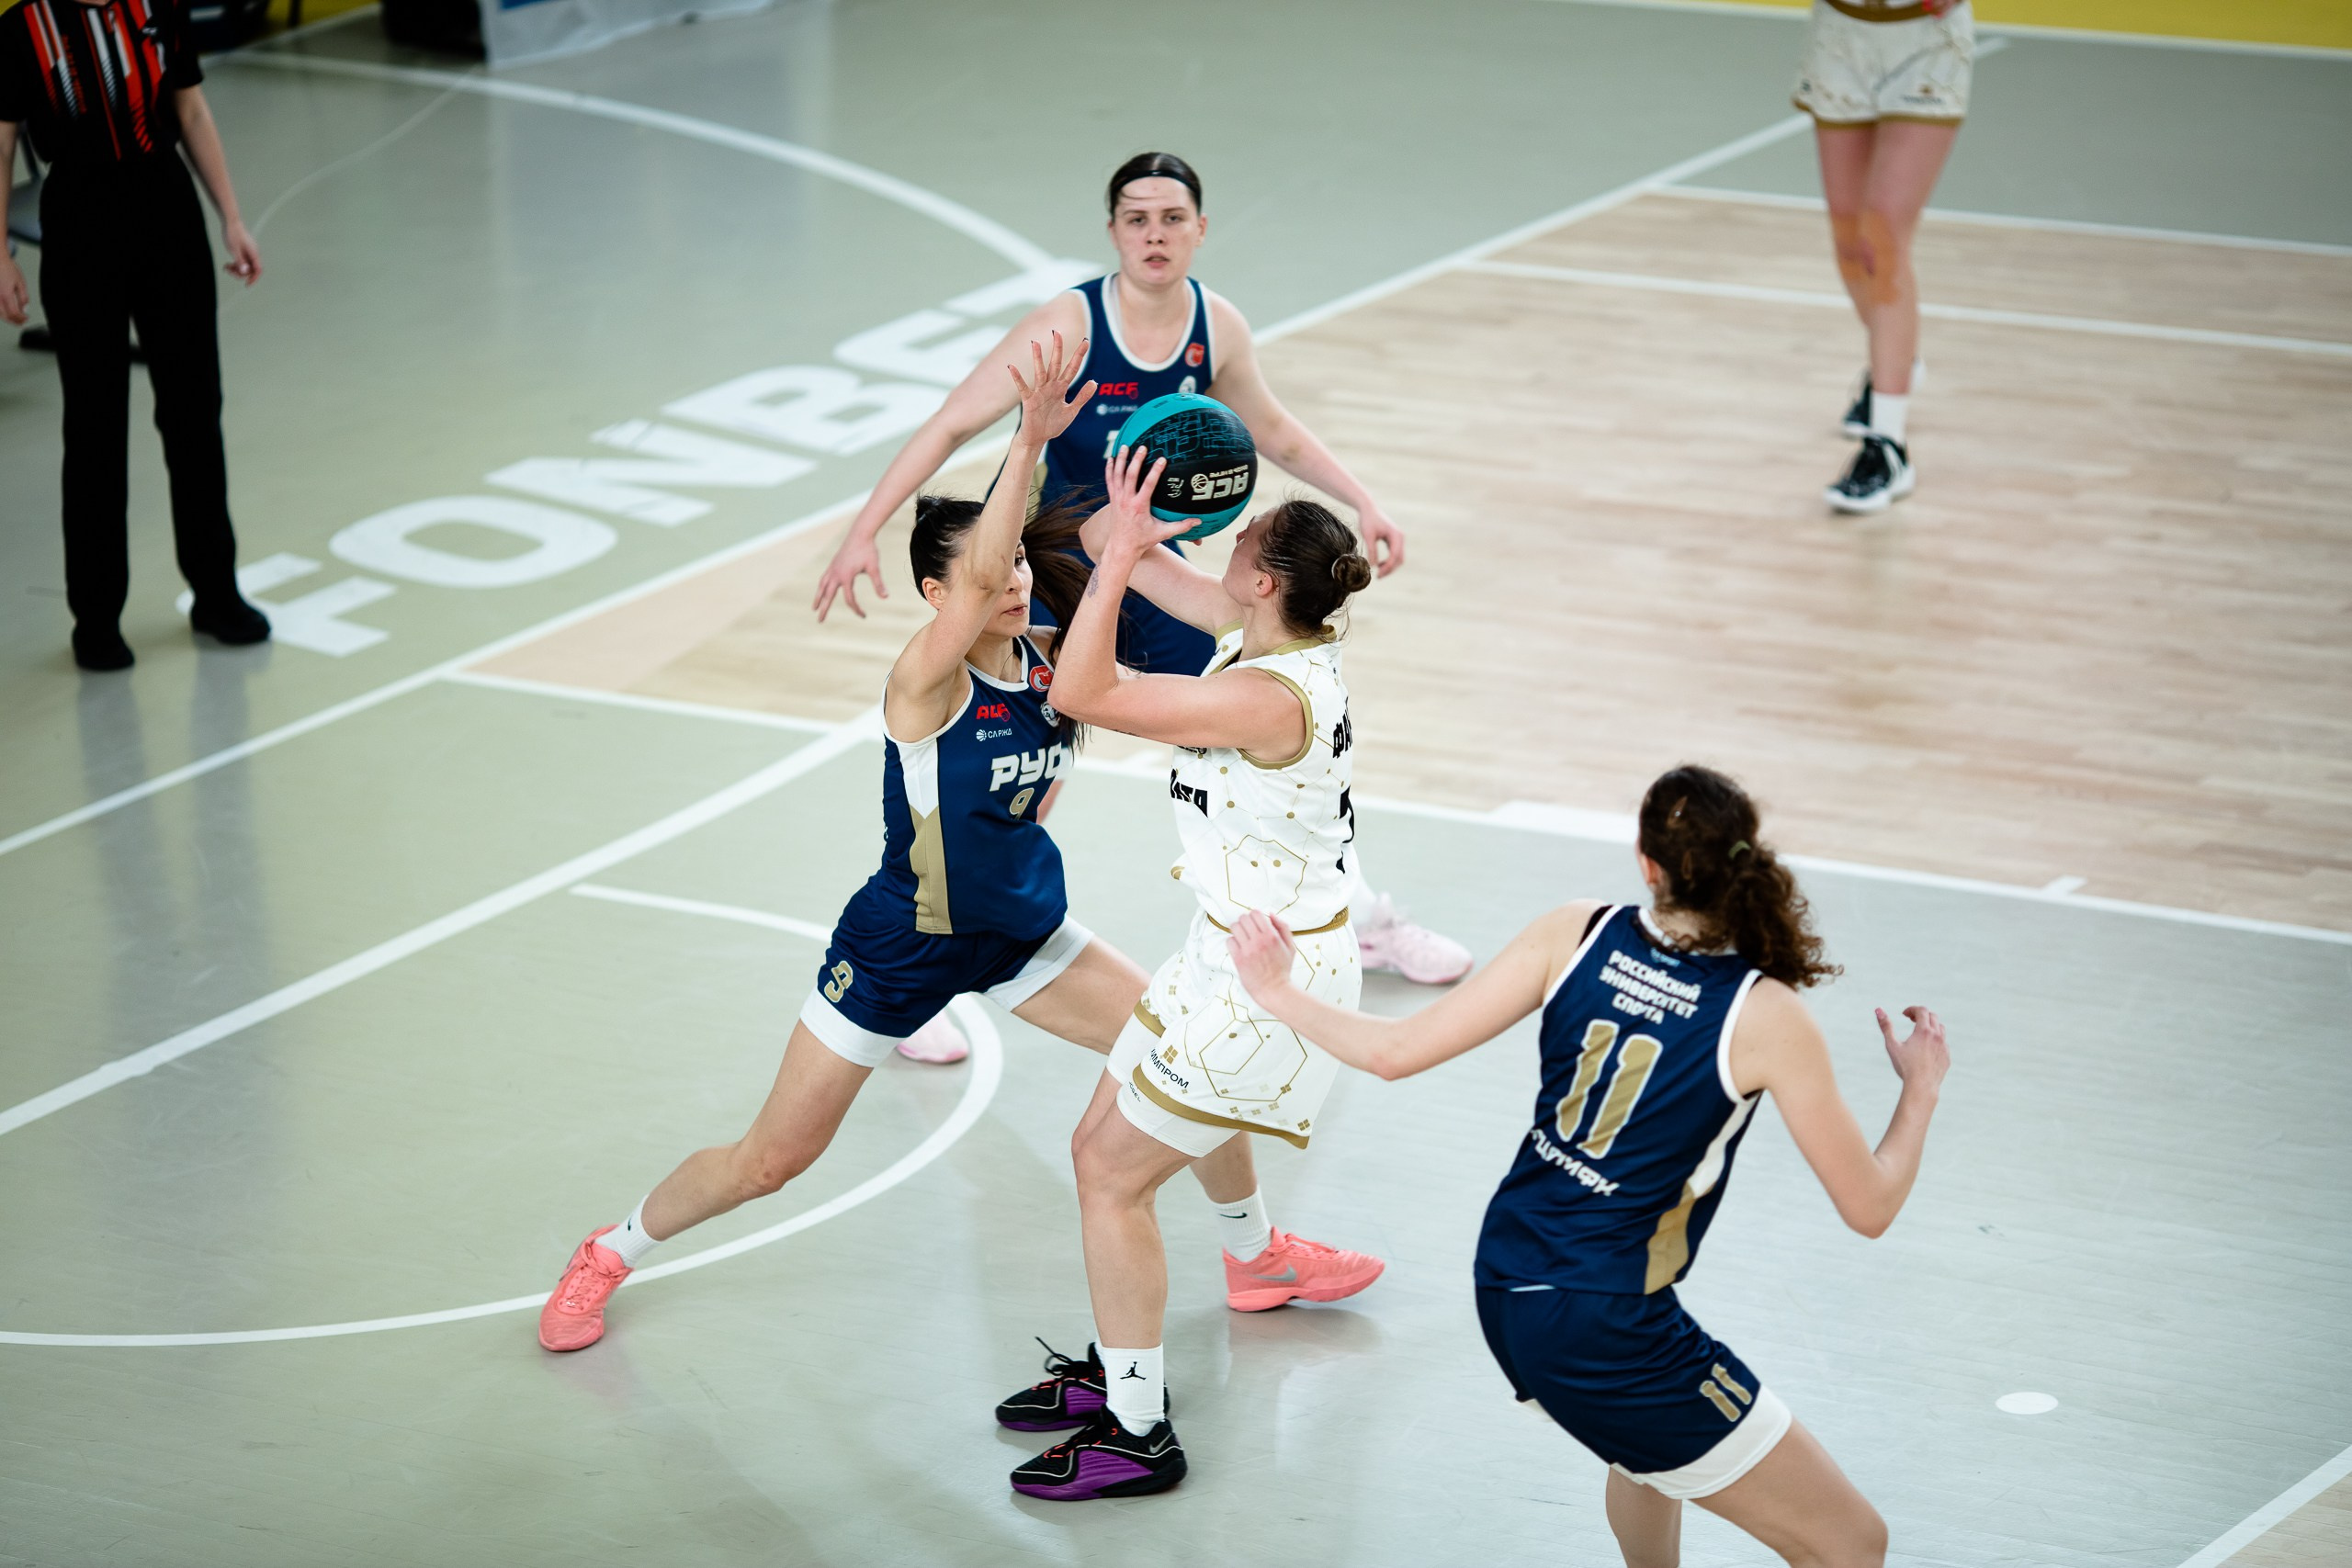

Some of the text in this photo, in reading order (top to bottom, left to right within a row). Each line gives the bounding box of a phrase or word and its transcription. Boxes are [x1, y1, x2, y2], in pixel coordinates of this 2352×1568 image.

[1608, 950, 1702, 1002] РОССИЙСКИЙ
[1555, 1019, 1664, 1159] 11
[1699, 1362, 1753, 1423] 11
